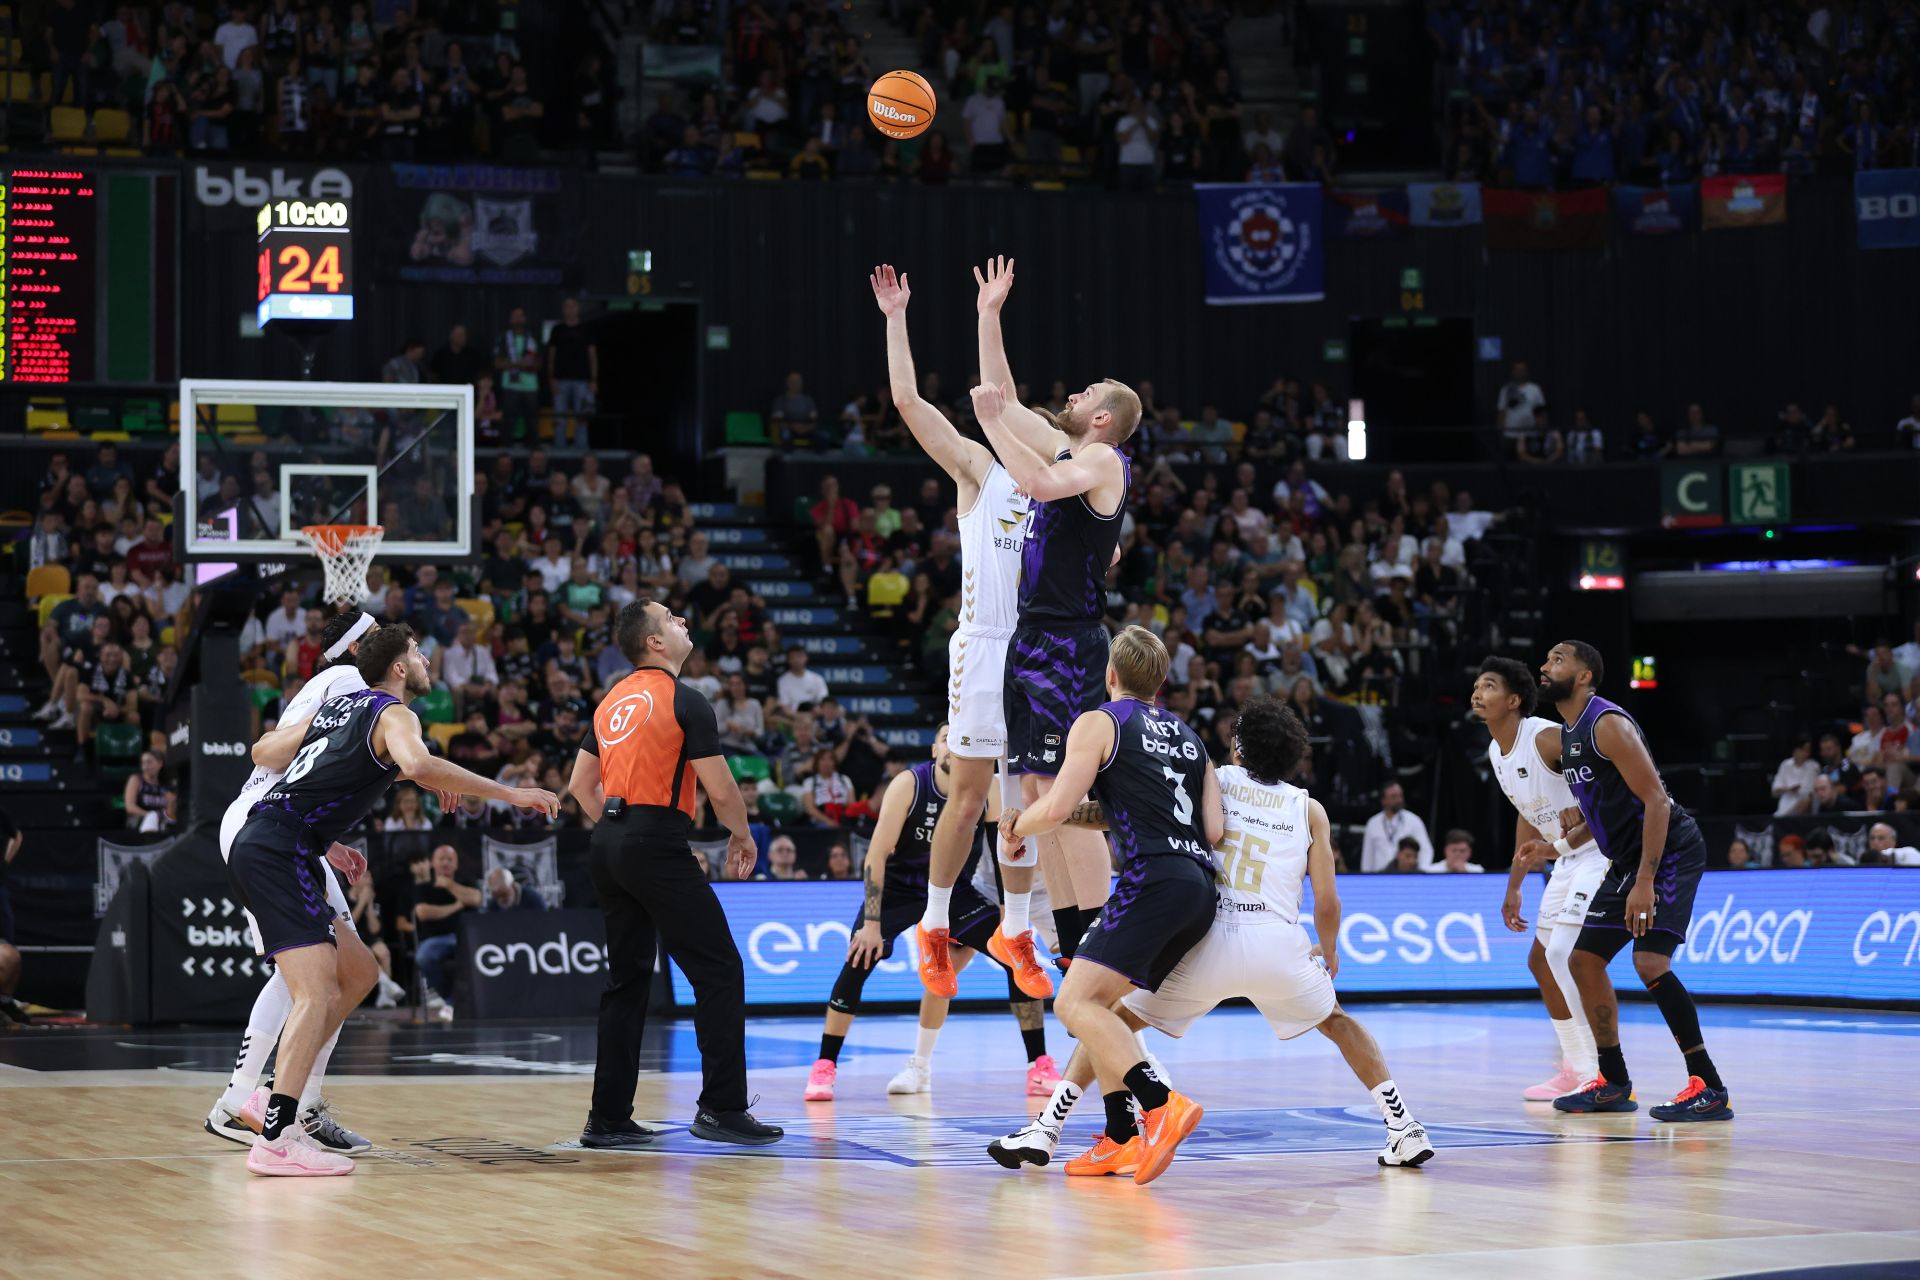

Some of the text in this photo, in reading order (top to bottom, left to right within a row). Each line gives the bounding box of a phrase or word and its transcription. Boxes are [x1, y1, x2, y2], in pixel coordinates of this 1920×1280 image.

[873, 100, 916, 123] Wilson
[274, 200, 348, 227] 10:00
[1858, 193, 1920, 220] BO
[278, 245, 344, 293] 24
[1676, 471, 1709, 513] C
[774, 609, 813, 625] IMQ
[823, 668, 864, 684] IMQ
[609, 704, 637, 733] 67
[851, 697, 892, 714] IMQ
[1142, 713, 1181, 737] FREY
[1162, 765, 1194, 826] 3
[1220, 781, 1286, 810] JACKSON
[1271, 821, 1294, 833] salud
[1852, 909, 1920, 967] en
[474, 931, 610, 977] ende
